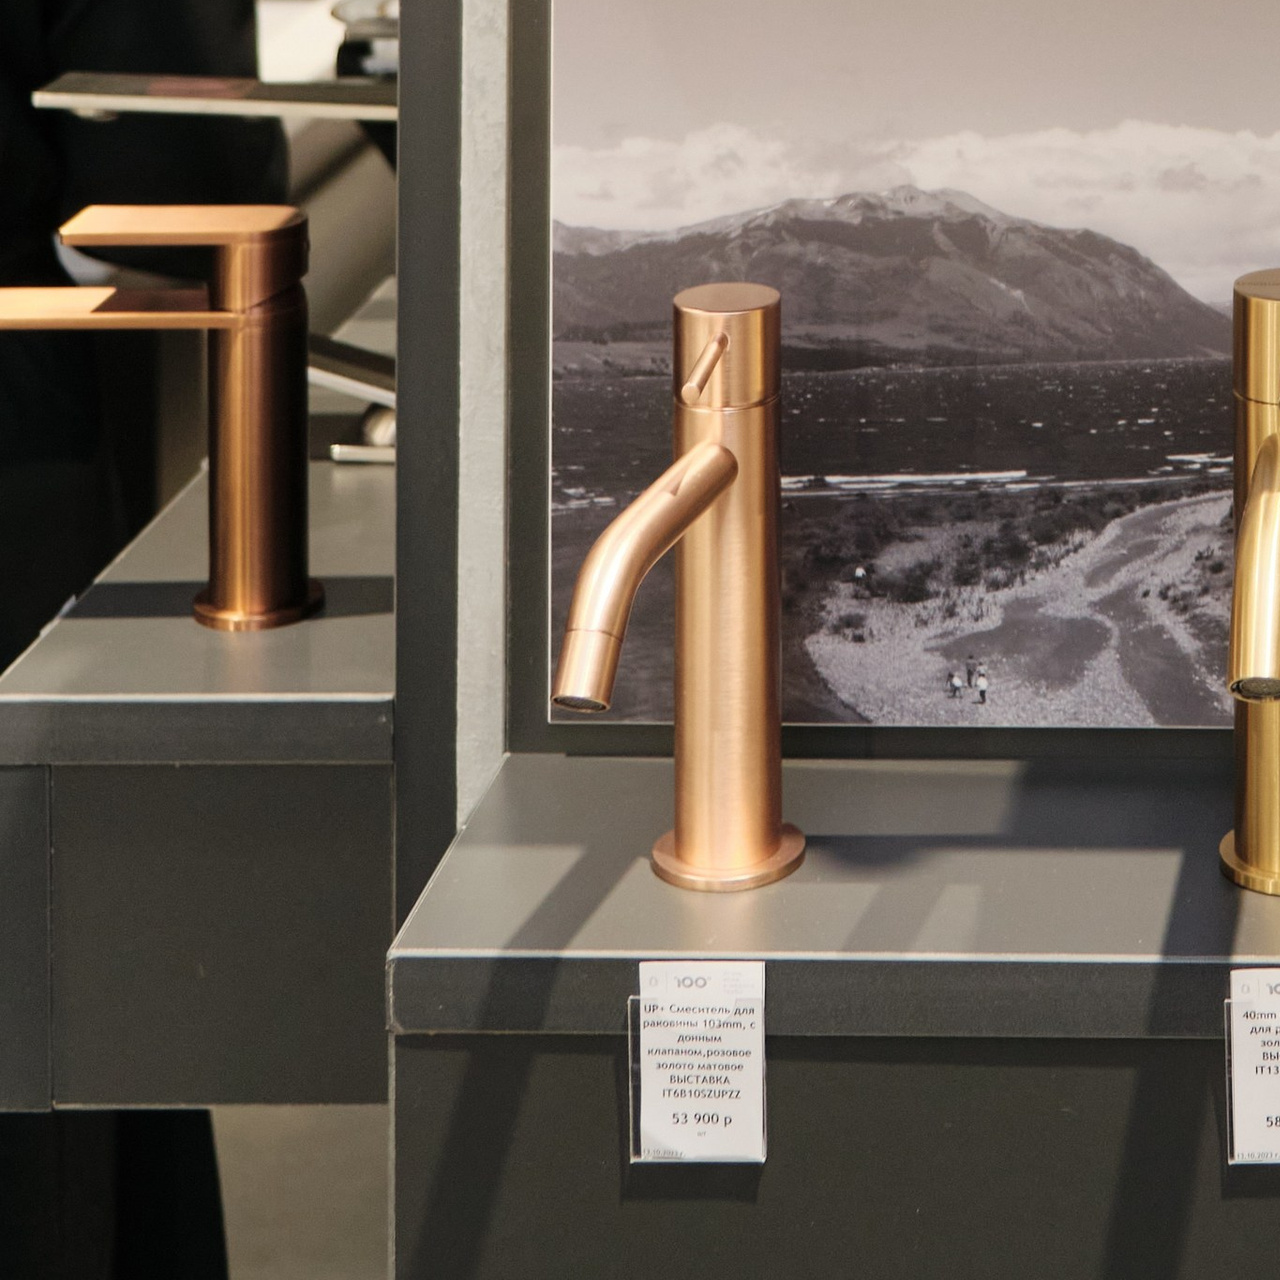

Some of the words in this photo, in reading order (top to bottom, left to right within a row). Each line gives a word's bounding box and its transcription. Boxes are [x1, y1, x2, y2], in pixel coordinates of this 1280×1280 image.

[644, 1004, 664, 1013] UP+
[669, 1004, 730, 1013] Смеситель
[734, 1007, 755, 1015] для
[643, 1020, 698, 1029] раковины
[1250, 1026, 1271, 1034] для
[677, 1034, 722, 1043] донным
[648, 1049, 751, 1058] клапаном,розовое
[670, 1075, 730, 1084] ВЫСТАВКА
[672, 1113, 687, 1124] 53
[694, 1113, 719, 1124] 900
